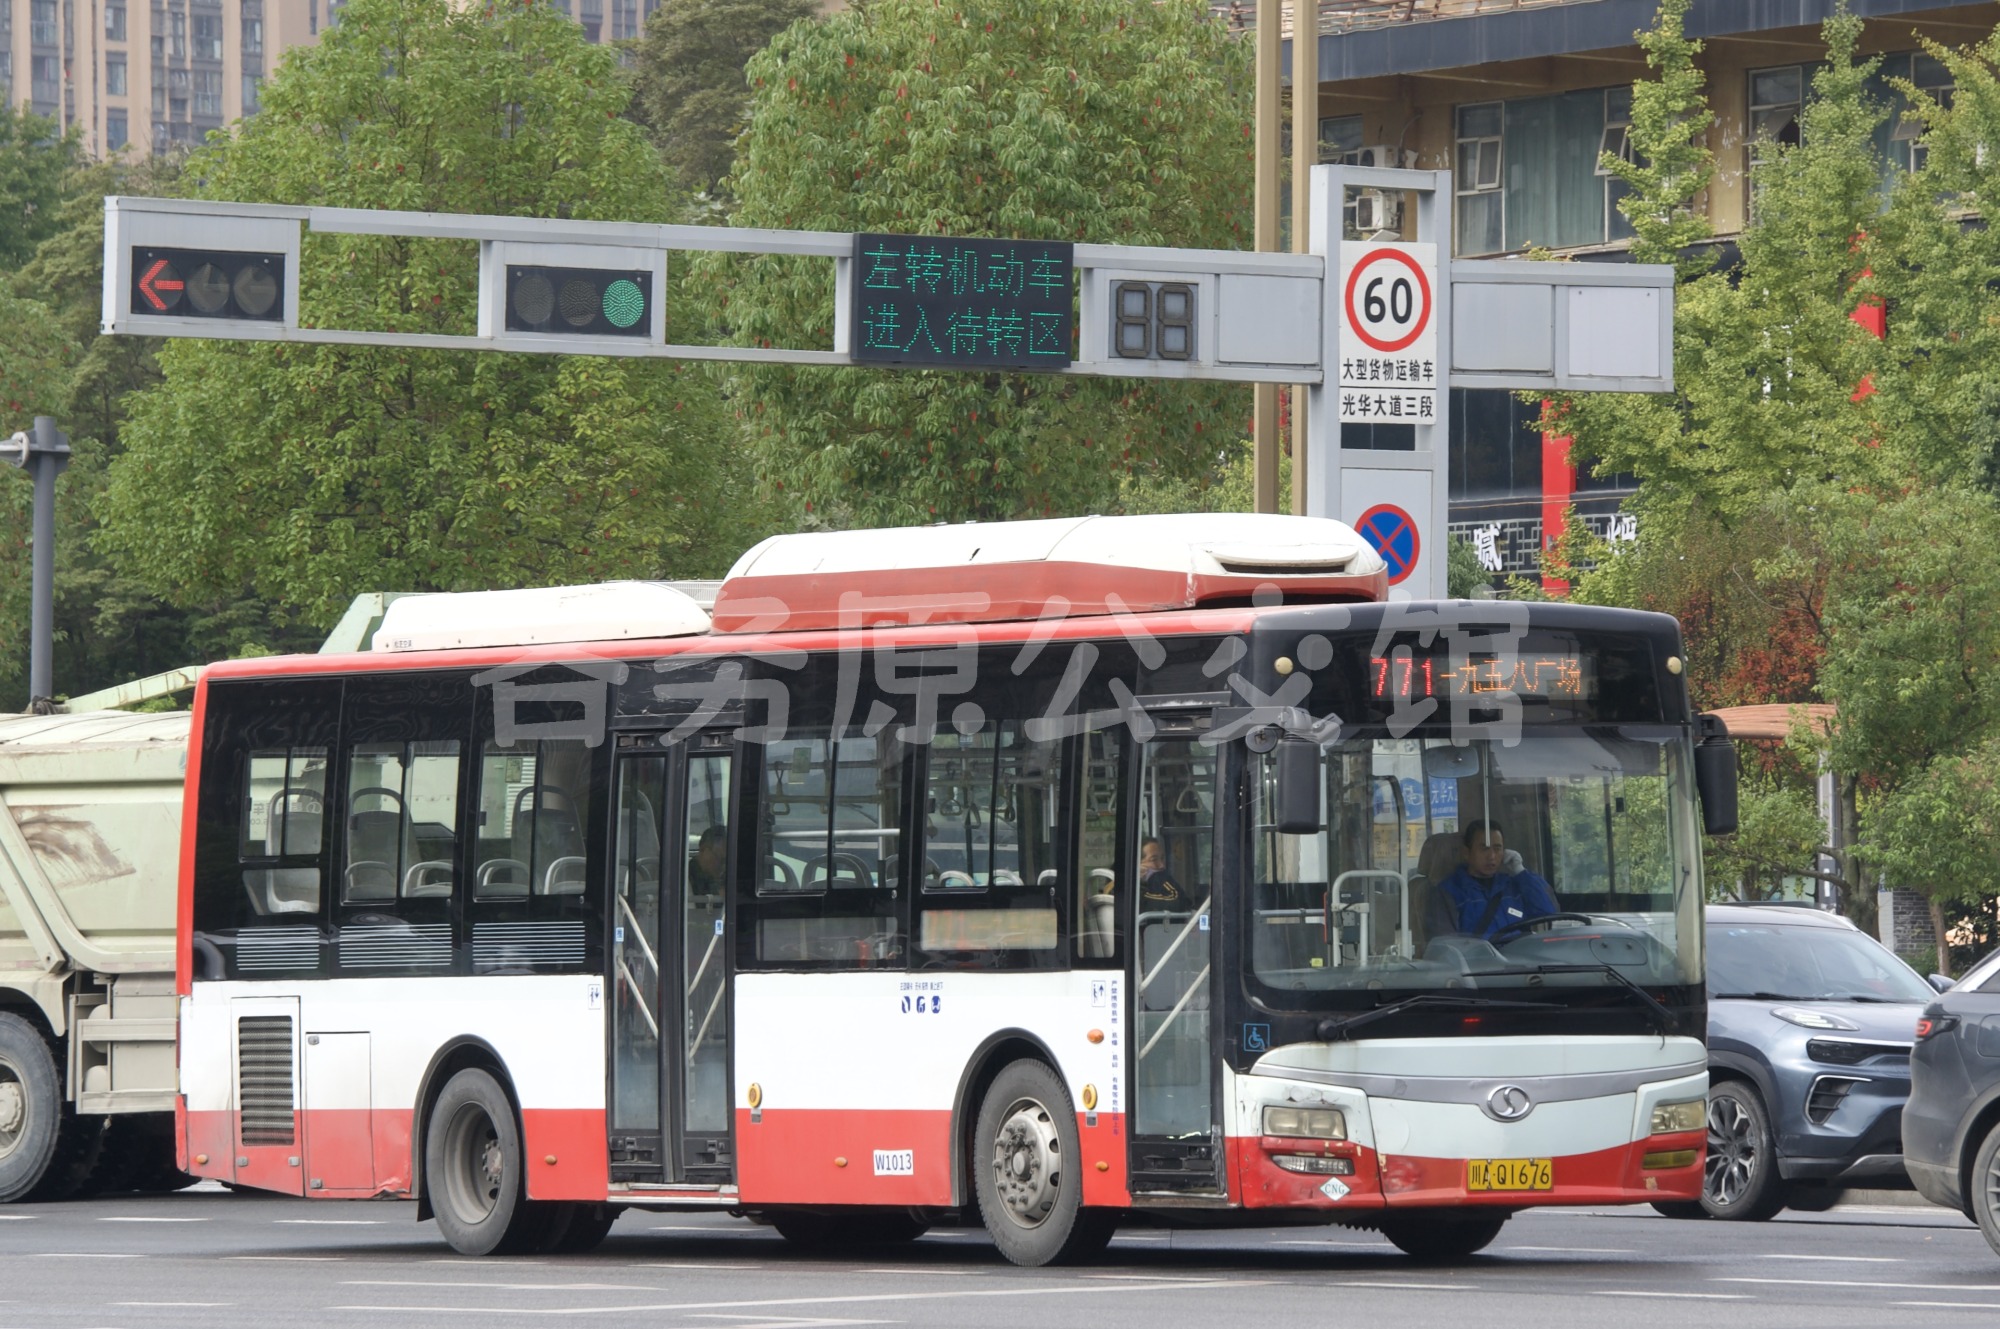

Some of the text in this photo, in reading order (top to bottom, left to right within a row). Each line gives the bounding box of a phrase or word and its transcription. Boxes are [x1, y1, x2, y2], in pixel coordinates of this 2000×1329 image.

[863, 243, 1065, 299] 左转机动车
[1364, 277, 1413, 324] 60
[862, 303, 1067, 356] 进入待转区
[1342, 357, 1434, 383] 大型货物运输车
[1342, 392, 1434, 418] 光华大道三段
[1371, 657, 1434, 696] 771
[875, 1153, 912, 1171] W1013
[1324, 1184, 1346, 1196] CNG
